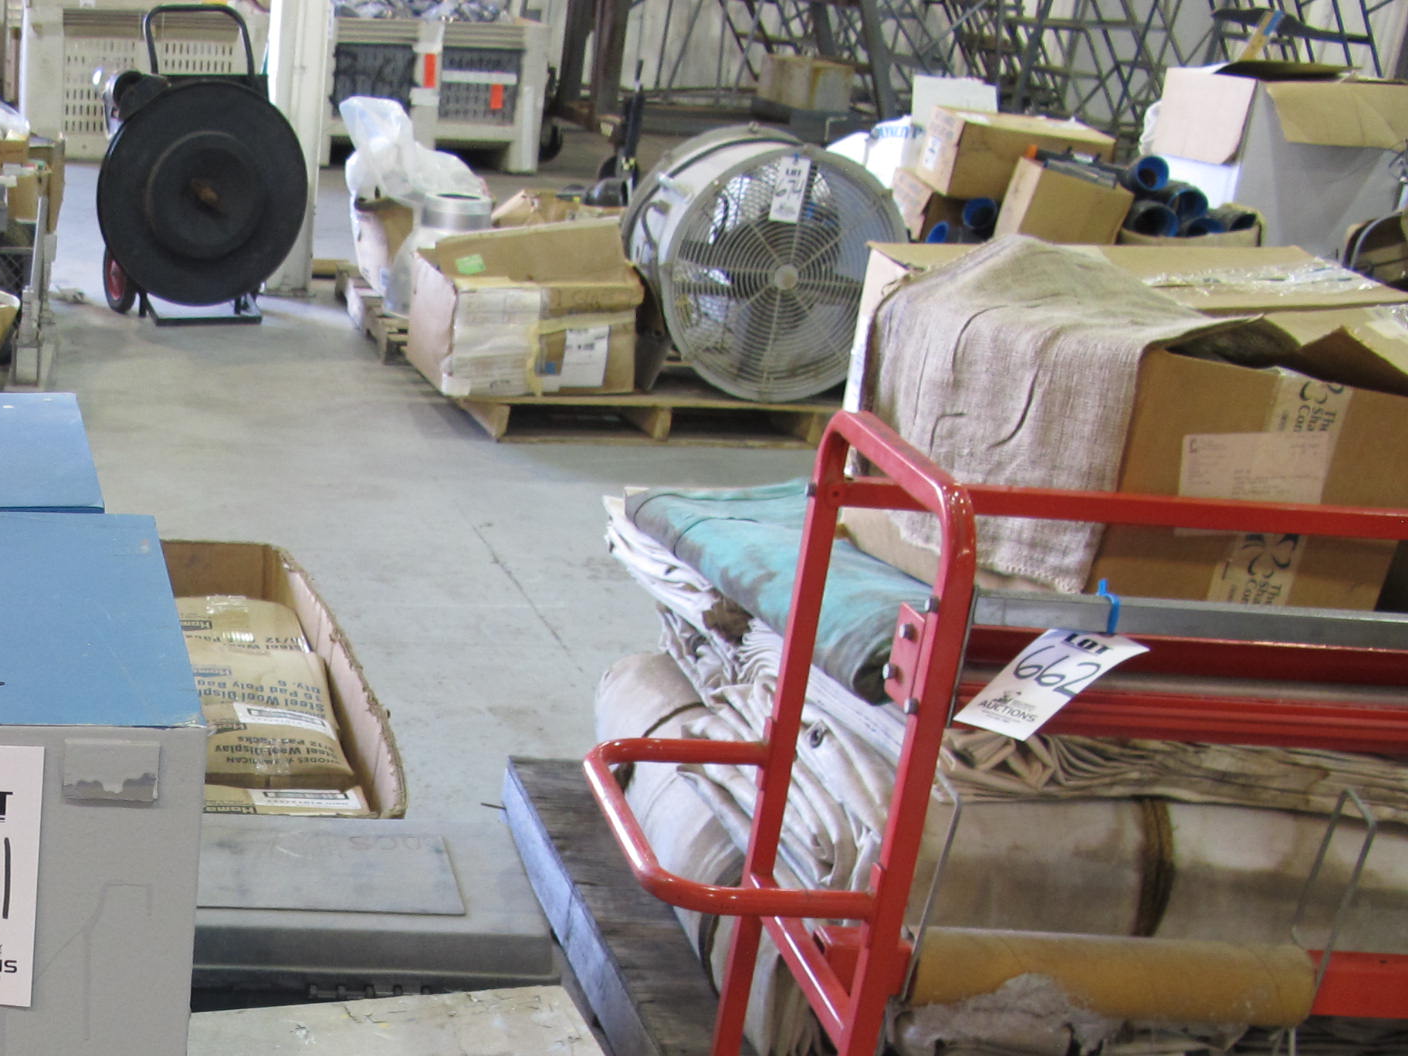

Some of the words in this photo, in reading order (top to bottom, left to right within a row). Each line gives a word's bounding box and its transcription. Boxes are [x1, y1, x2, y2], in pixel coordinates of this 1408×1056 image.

[1063, 632, 1113, 656] LOT
[1013, 645, 1101, 697] 662
[241, 692, 280, 706] Wool
[284, 698, 325, 712] Steel
[978, 699, 1039, 722] AUCTIONS
